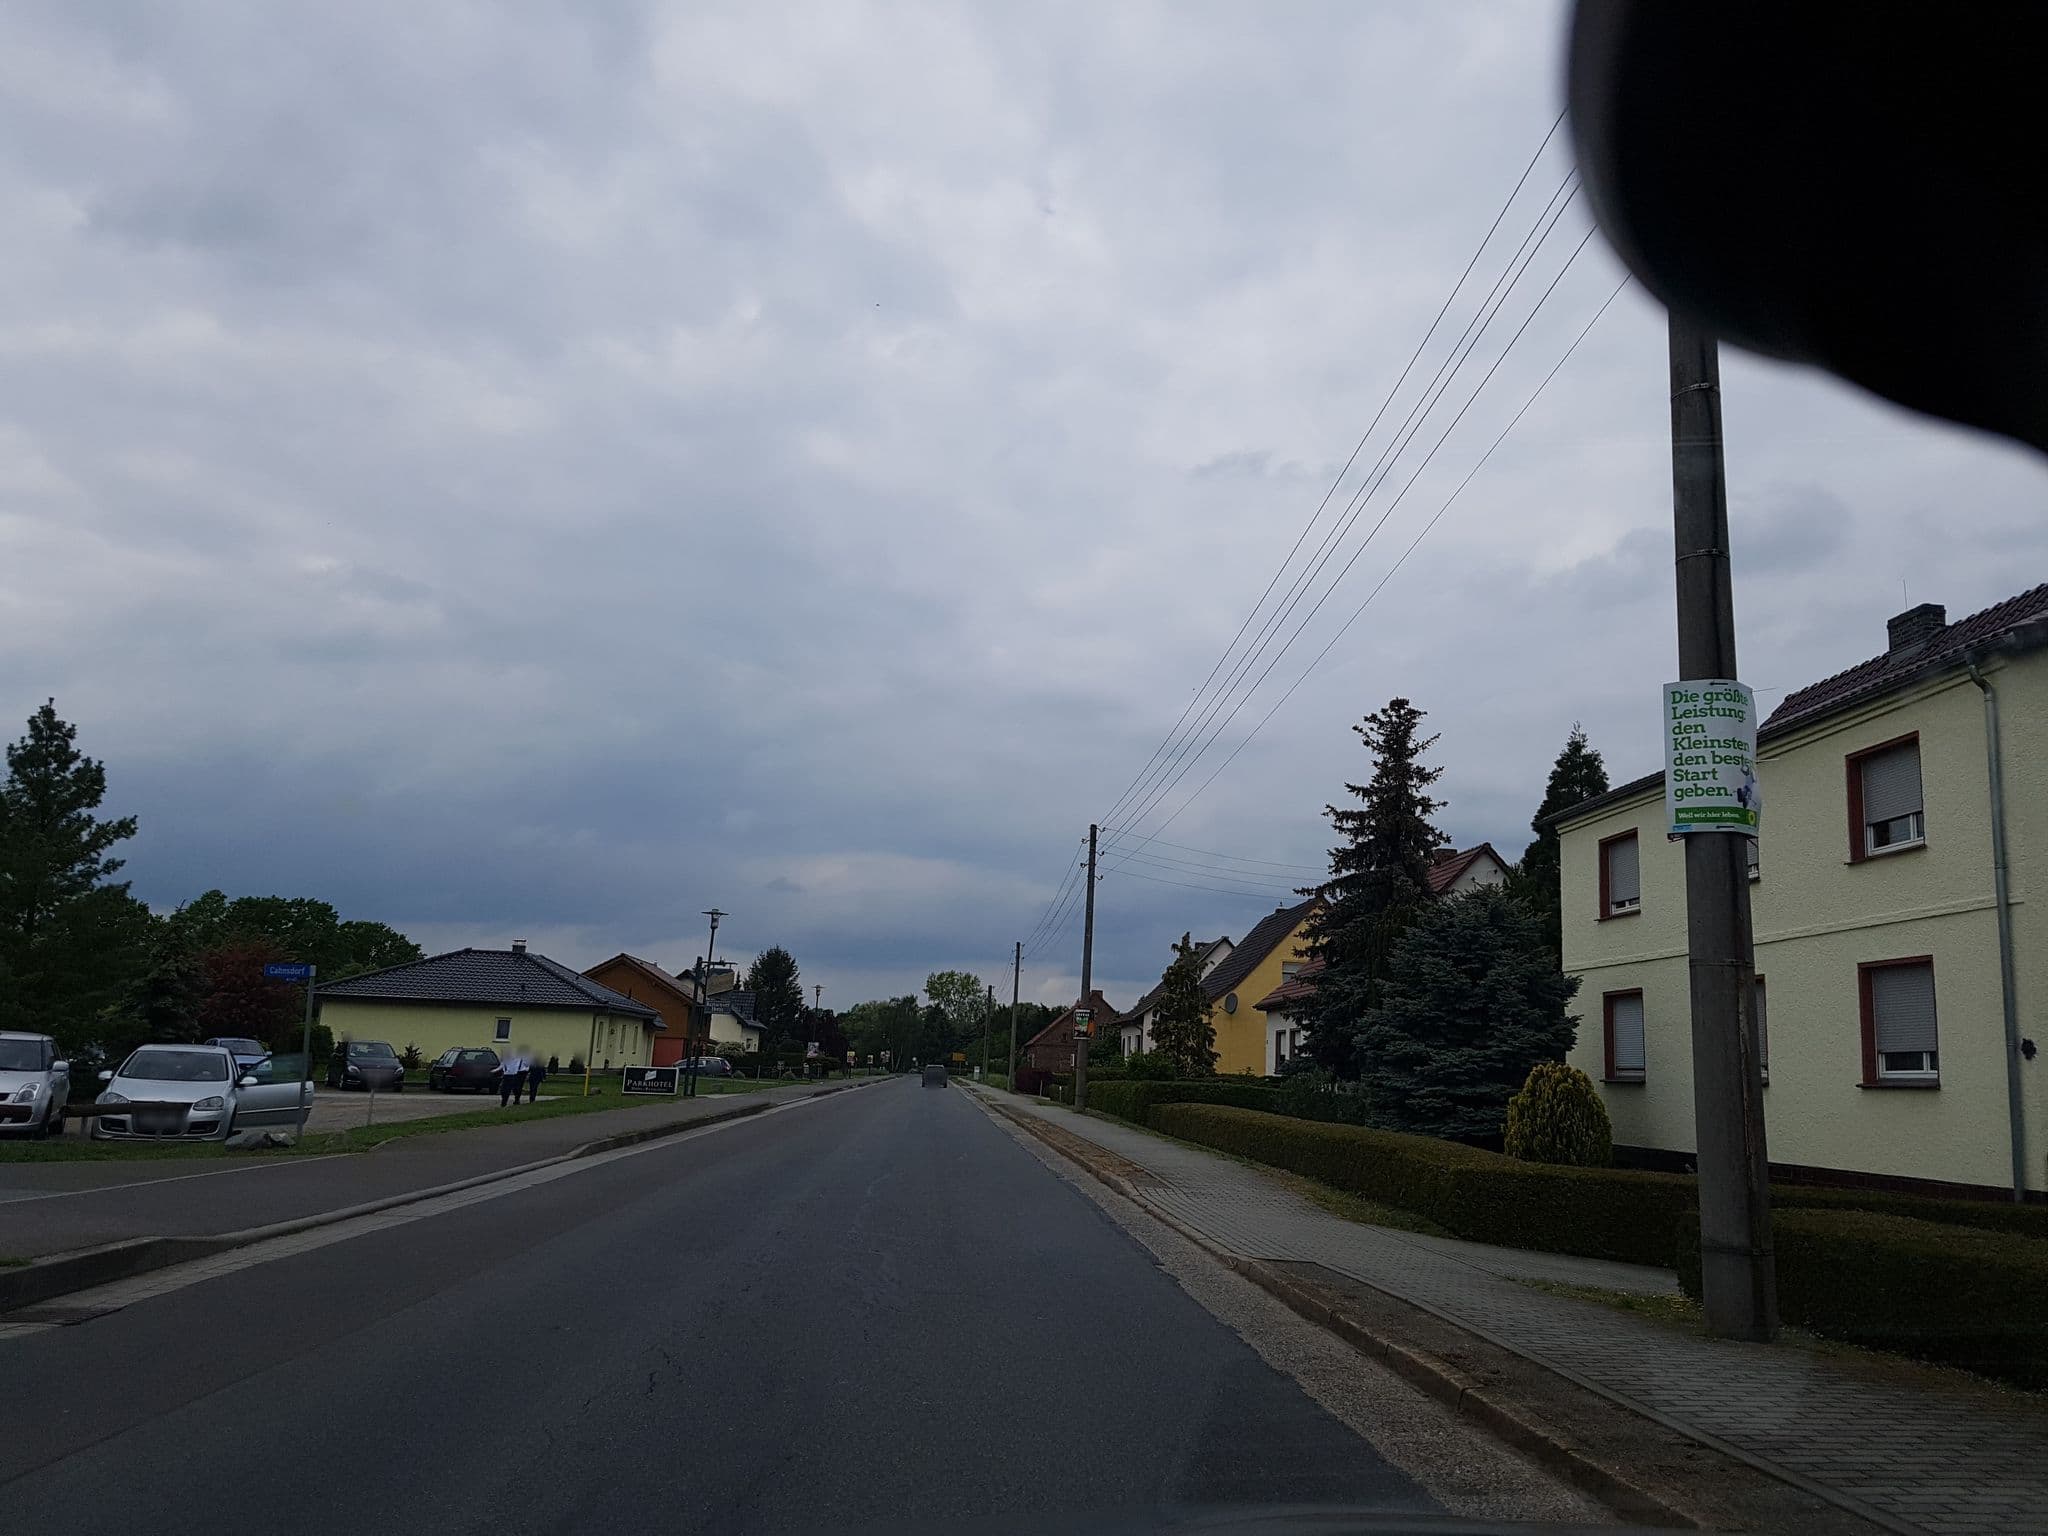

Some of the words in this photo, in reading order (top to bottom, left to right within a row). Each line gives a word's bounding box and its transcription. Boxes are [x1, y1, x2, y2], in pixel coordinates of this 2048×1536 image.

[1671, 690, 1699, 704] Die
[1672, 721, 1706, 736] den
[1673, 735, 1750, 752] Kleinsten
[1673, 752, 1707, 766] den
[1673, 767, 1718, 782] Start
[1674, 783, 1733, 802] geben.
